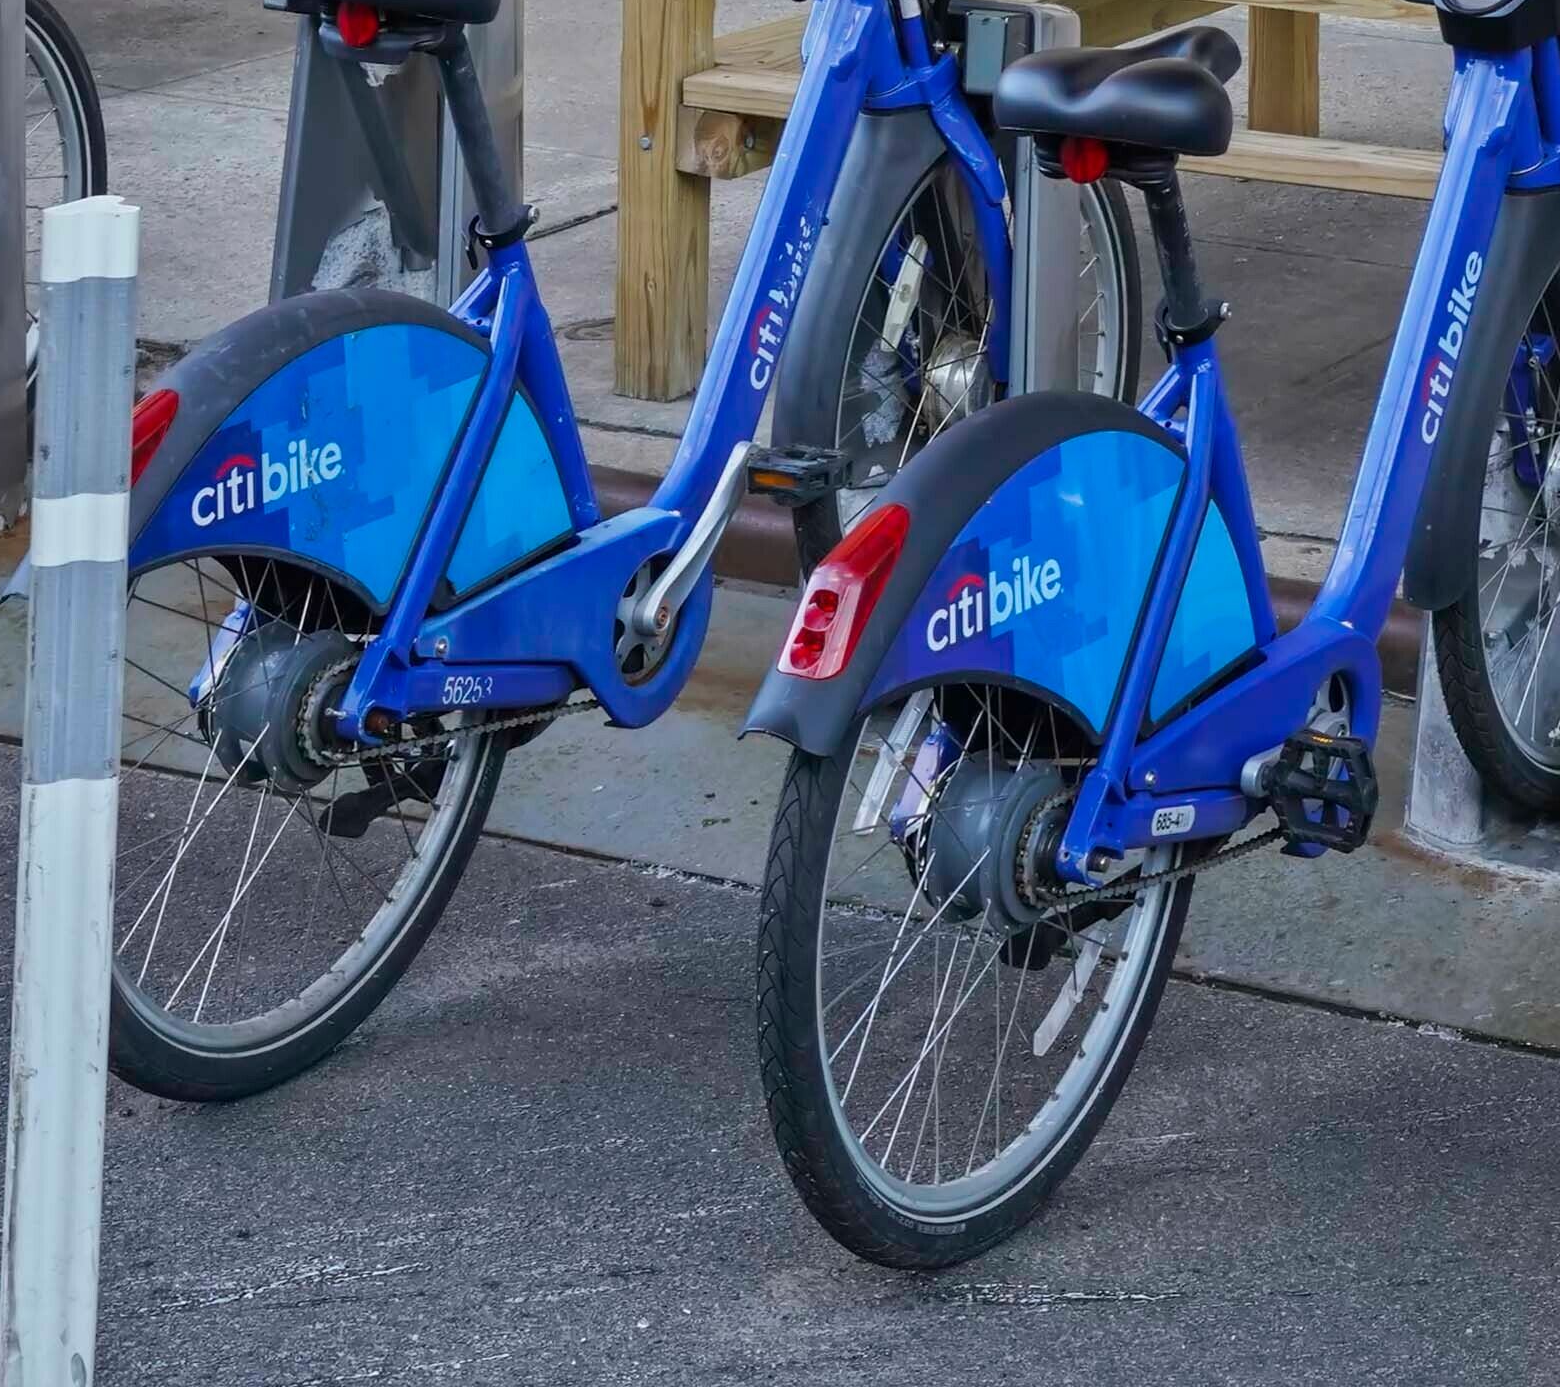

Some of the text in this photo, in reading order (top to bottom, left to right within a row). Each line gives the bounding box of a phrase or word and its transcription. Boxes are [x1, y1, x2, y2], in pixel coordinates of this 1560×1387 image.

[748, 311, 784, 391] citi
[1420, 250, 1486, 446] citi bike
[191, 440, 342, 528] citi bike
[926, 556, 1062, 653] citi bike
